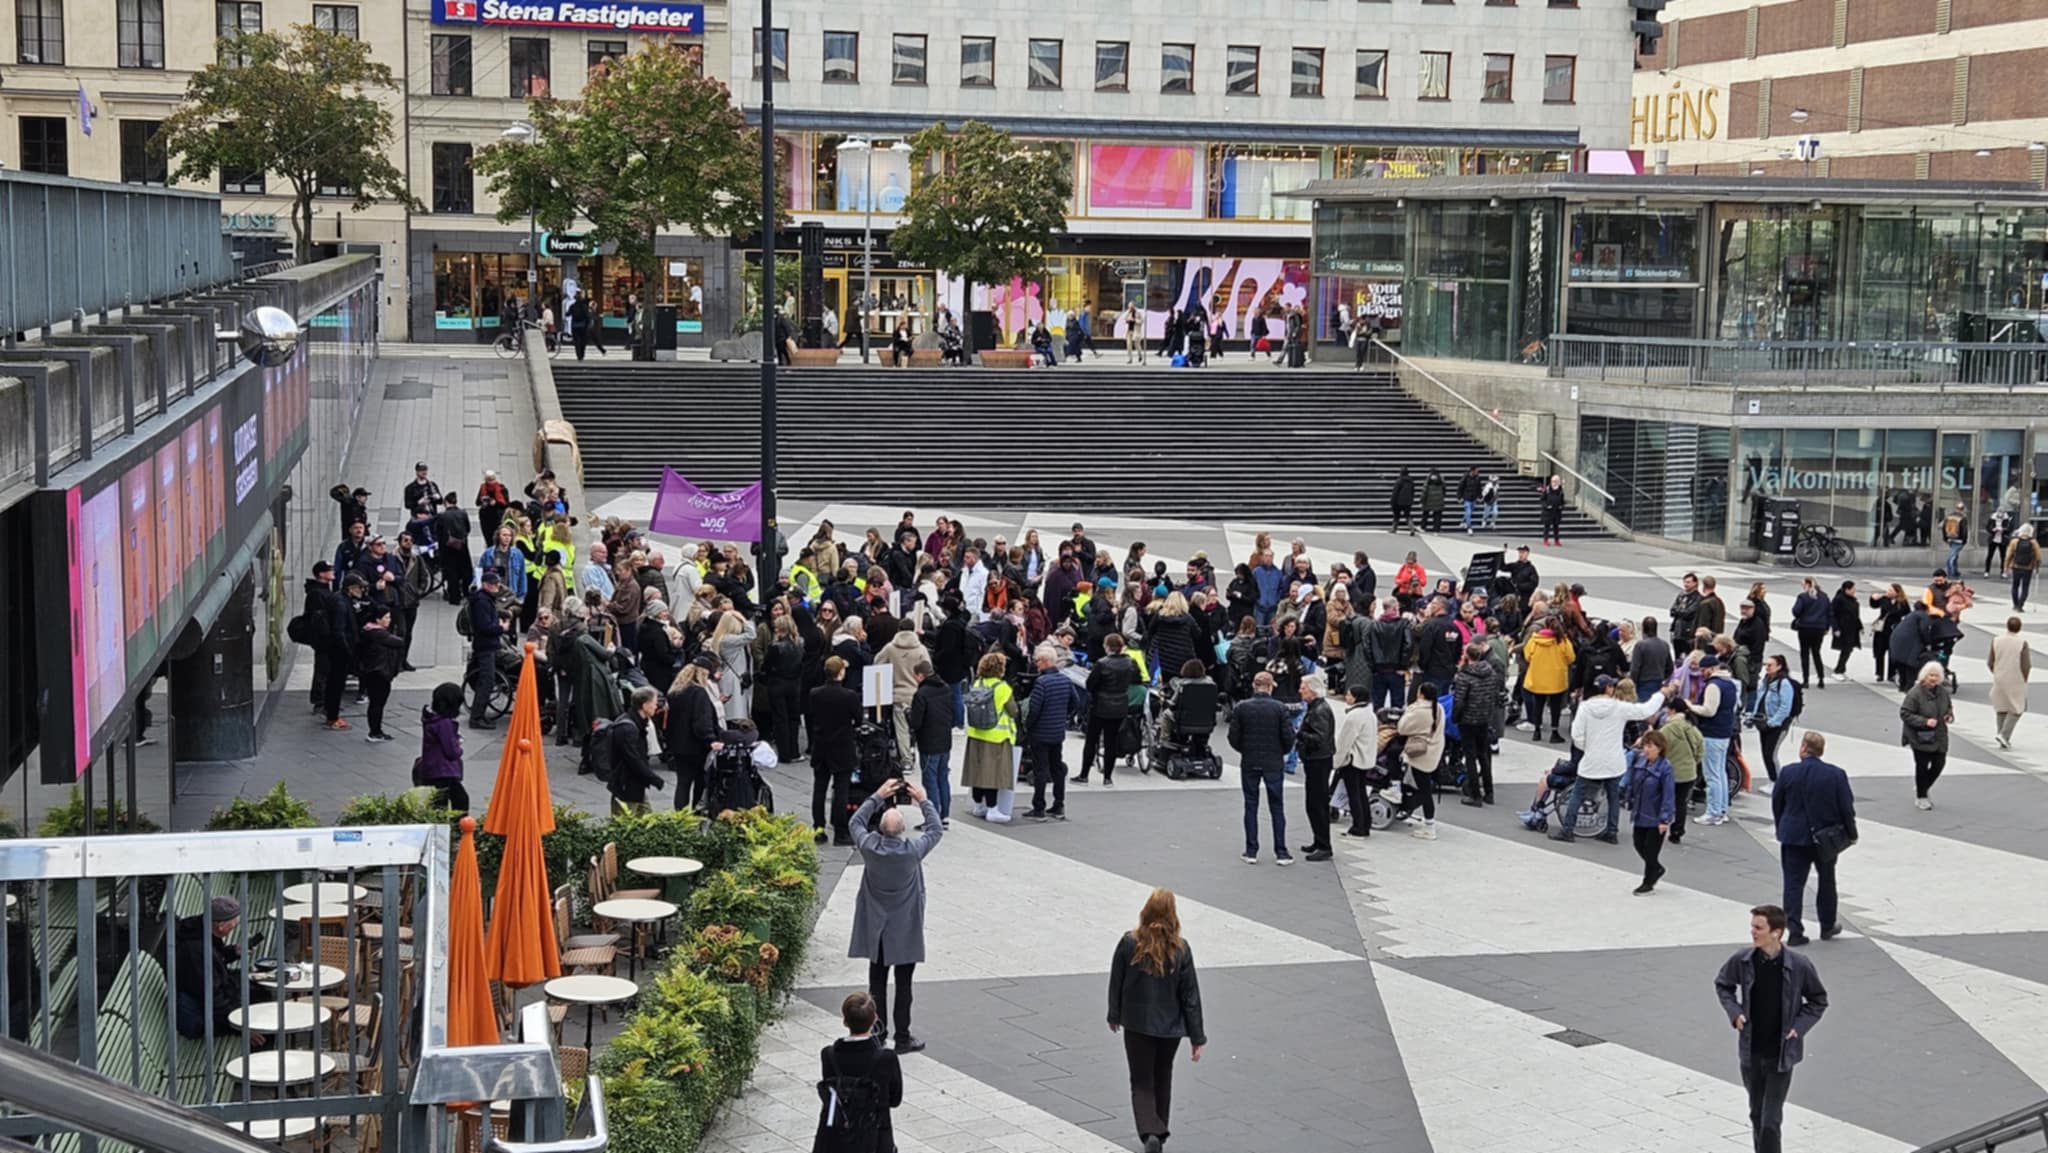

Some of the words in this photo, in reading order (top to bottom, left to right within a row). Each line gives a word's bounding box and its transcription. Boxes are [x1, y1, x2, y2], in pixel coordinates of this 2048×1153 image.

[456, 2, 465, 16] S
[482, 0, 554, 21] Stena
[559, 3, 694, 28] Fastigheter
[1810, 140, 1820, 158] T
[550, 238, 588, 250] Norma
[1668, 269, 1682, 278] City
[1368, 283, 1402, 296] your
[1750, 465, 1895, 490] Välkommen
[1901, 465, 1934, 490] till
[1941, 466, 1973, 490] SL
